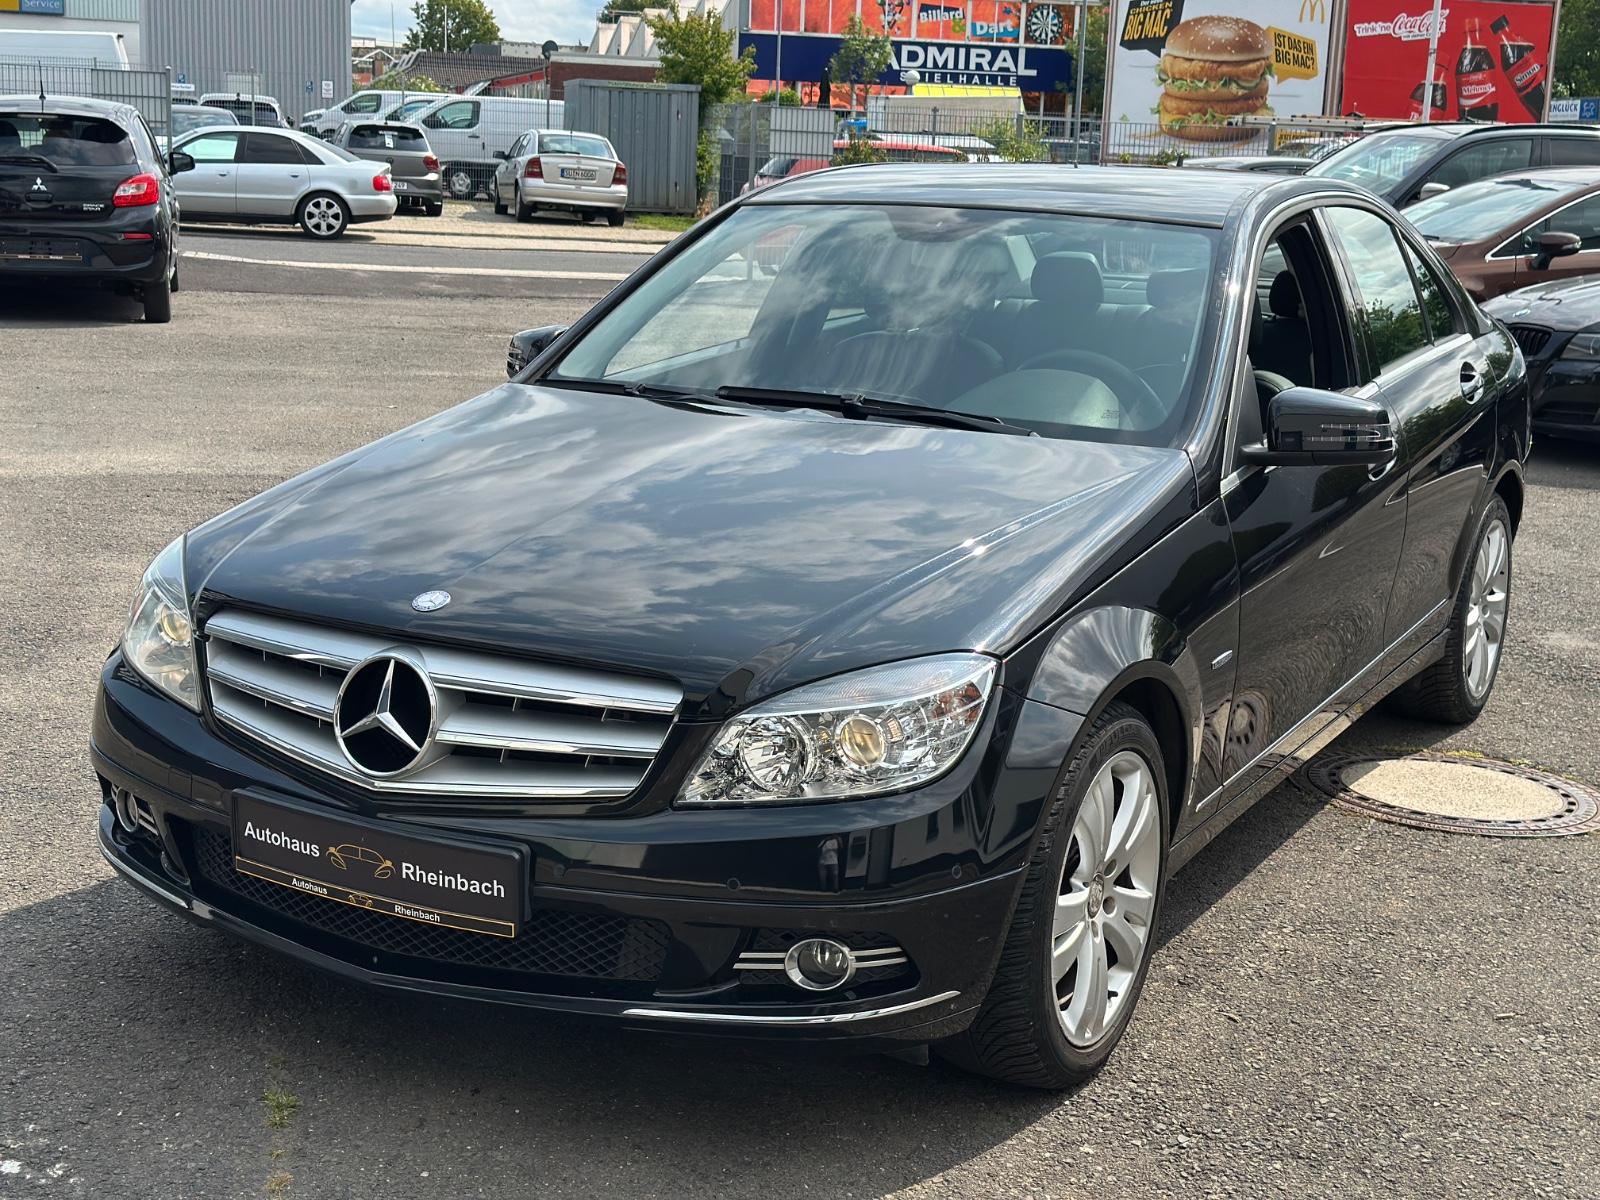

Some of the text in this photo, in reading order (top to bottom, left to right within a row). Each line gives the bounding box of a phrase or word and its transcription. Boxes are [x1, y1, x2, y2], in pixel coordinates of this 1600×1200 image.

[24, 0, 60, 9] Service
[1130, 1, 1173, 14] CHICKEN
[919, 8, 965, 23] Billard
[975, 19, 1014, 35] Dart
[1123, 9, 1171, 40] BIG MAC
[1357, 25, 1377, 34] Trink
[1274, 32, 1314, 57] IST DAS EIN
[1275, 48, 1315, 70] BIG MAC?
[899, 71, 1017, 86] SIELHALLE
[244, 821, 506, 898] Autohaus Rheinbach
[291, 877, 441, 923] Autohaus Rheinbach
